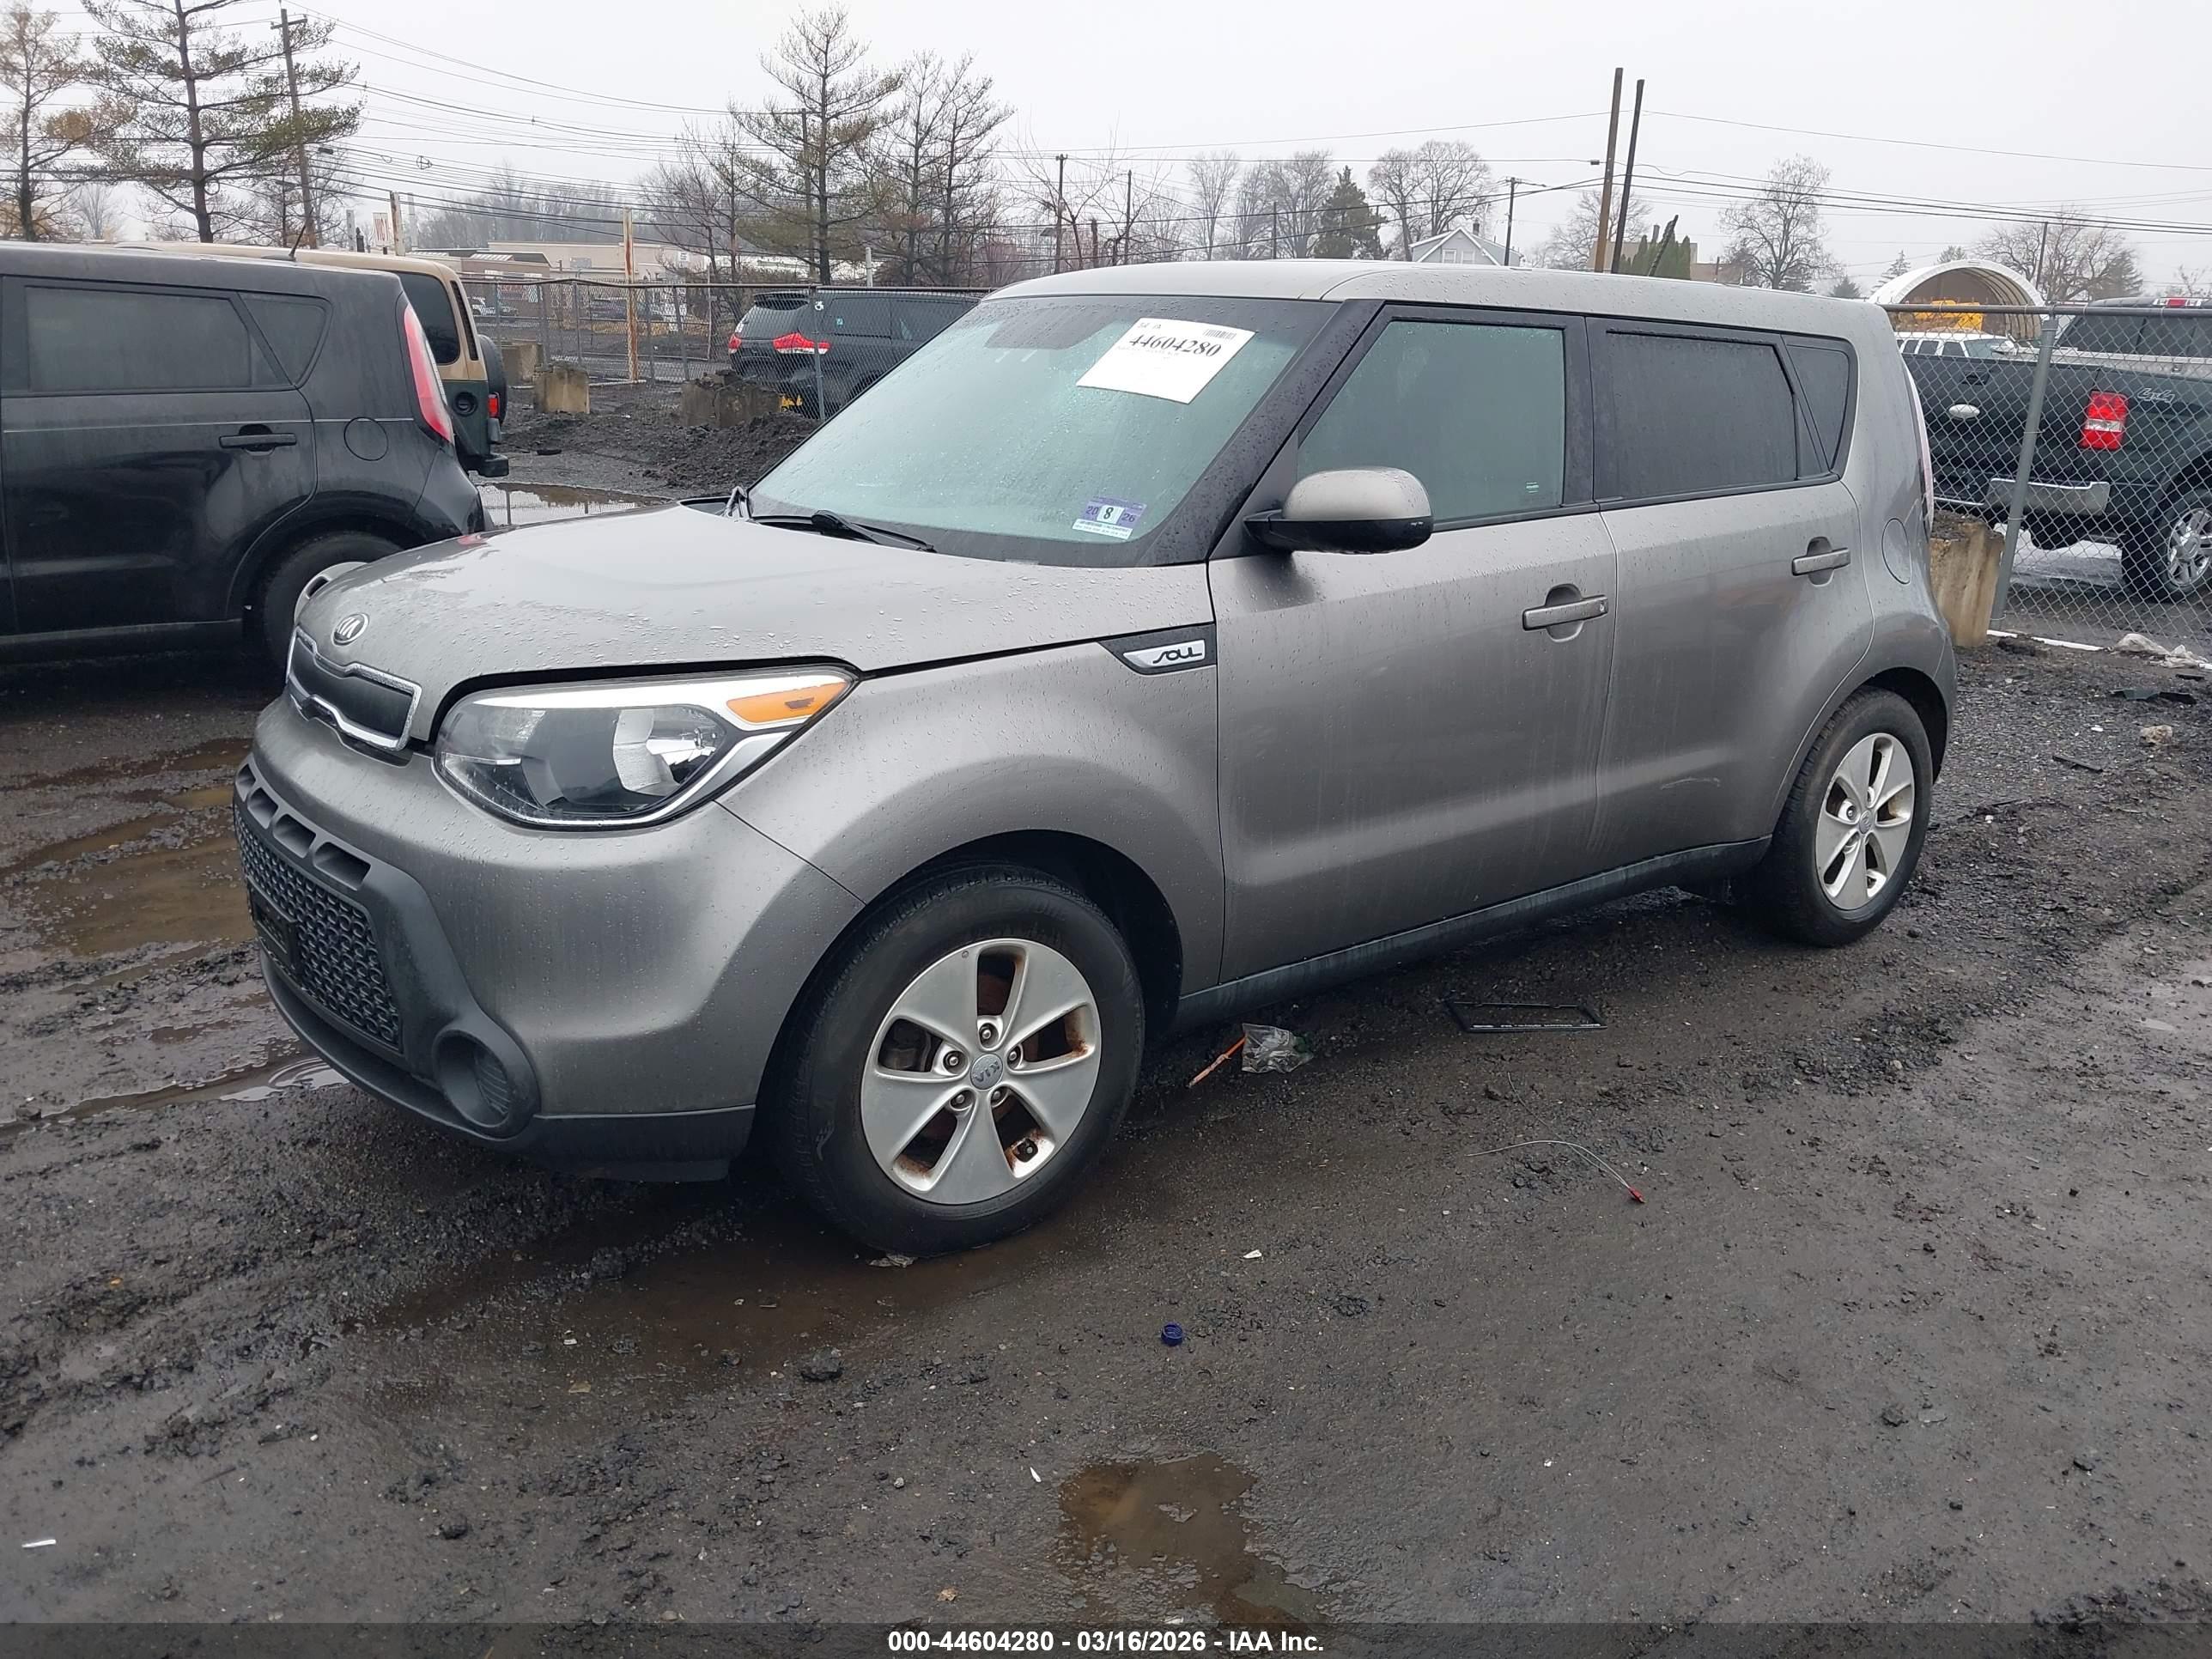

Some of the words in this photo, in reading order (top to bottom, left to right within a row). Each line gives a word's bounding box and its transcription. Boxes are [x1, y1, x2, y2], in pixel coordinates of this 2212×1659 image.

[1129, 335, 1222, 357] 44604280
[1085, 505, 1099, 516] 20
[1103, 507, 1115, 520] 8
[1121, 513, 1136, 523] 26
